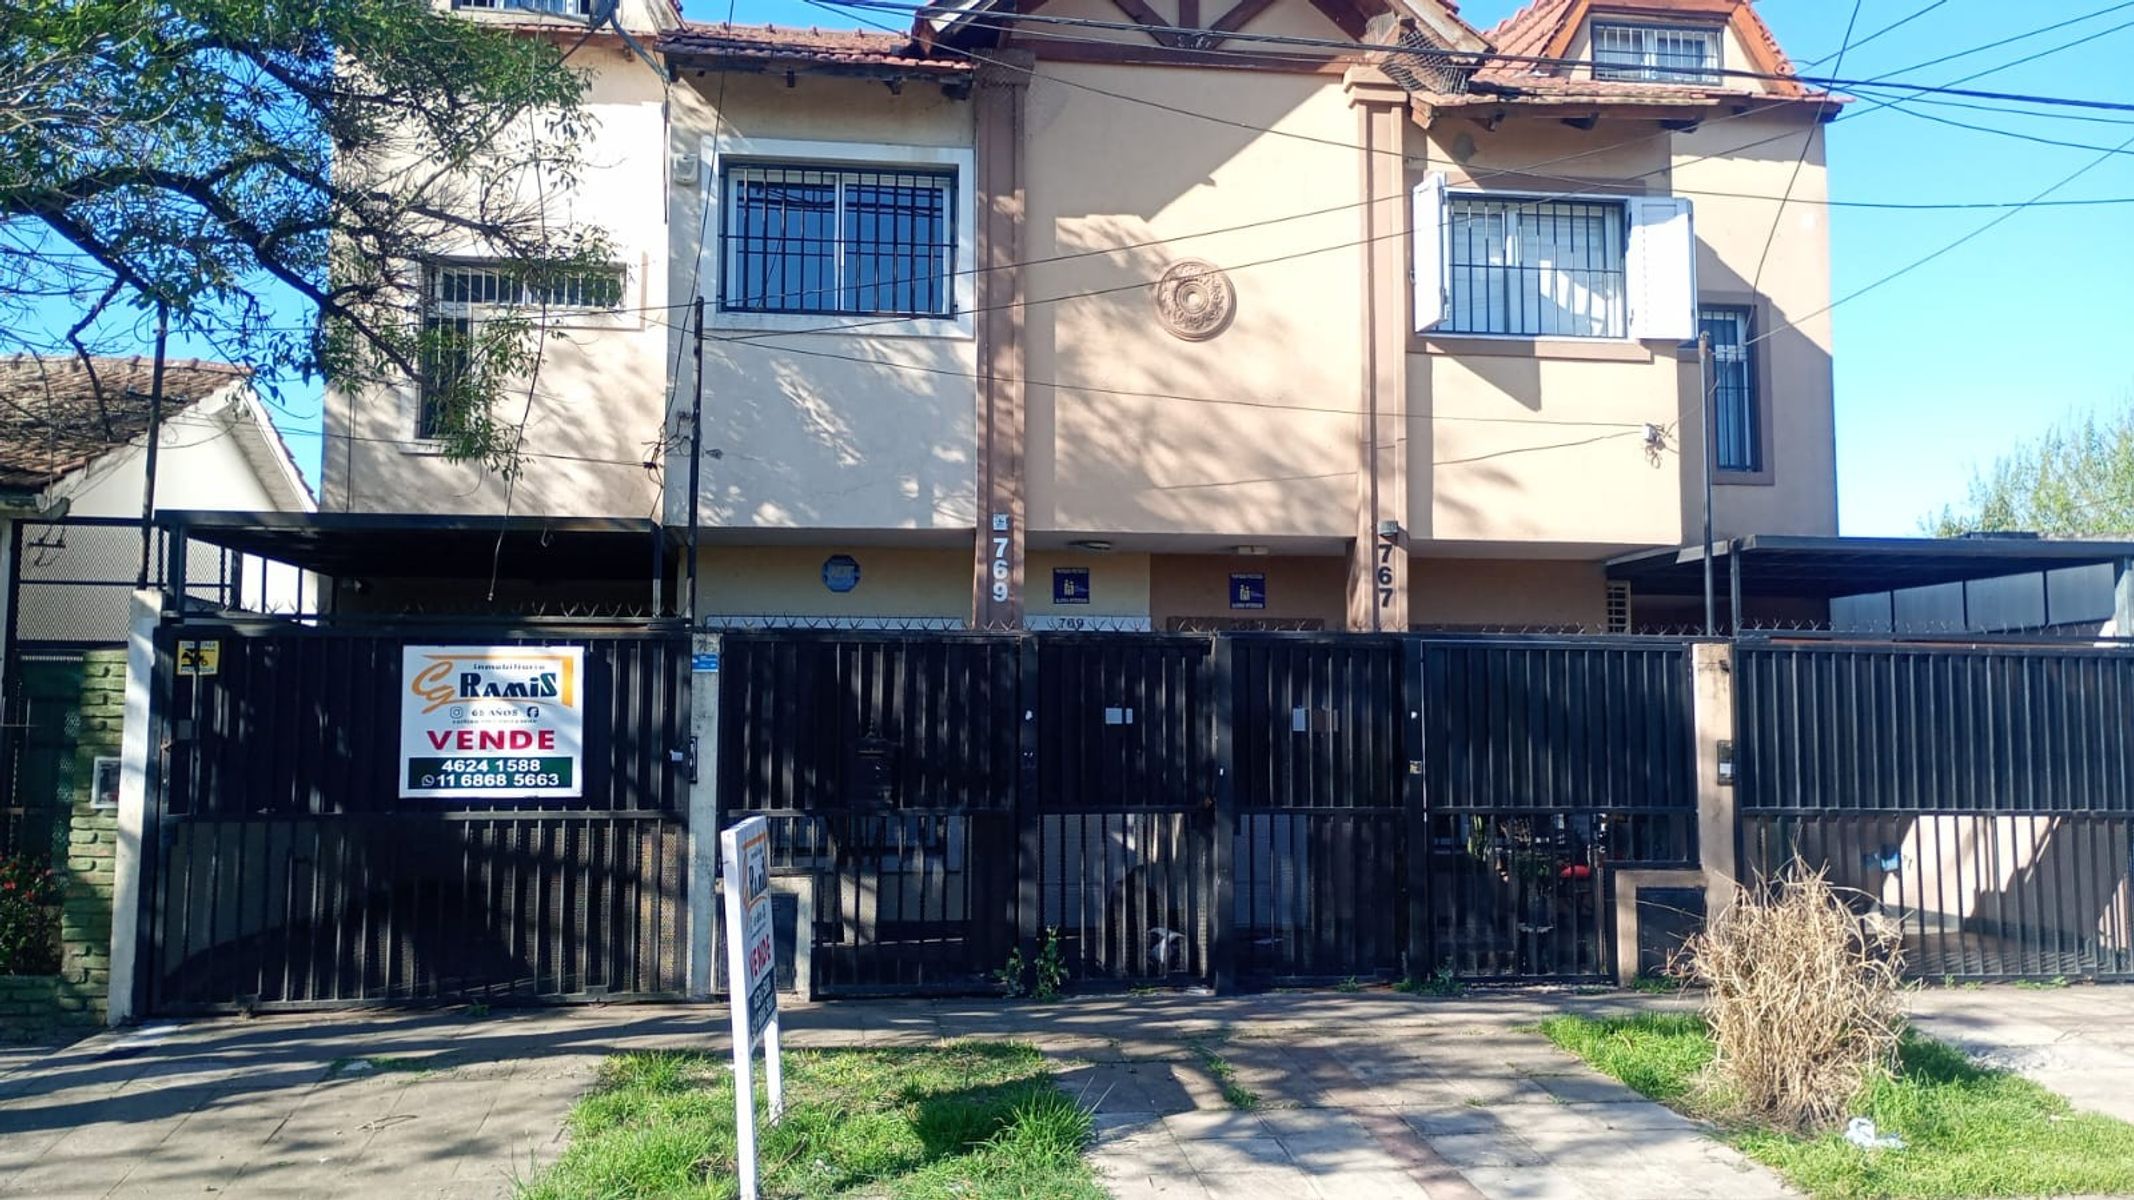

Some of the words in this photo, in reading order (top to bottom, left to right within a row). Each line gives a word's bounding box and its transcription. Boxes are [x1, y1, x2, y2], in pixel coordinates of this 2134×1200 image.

[993, 537, 1008, 602] 769
[1378, 544, 1393, 608] 767
[1059, 618, 1084, 628] 769
[426, 730, 555, 750] VENDE
[441, 759, 489, 772] 4624
[495, 759, 541, 772] 1588
[437, 774, 455, 786] 11
[460, 774, 507, 786] 6868
[513, 774, 559, 786] 5663
[749, 933, 771, 980] VENDE
